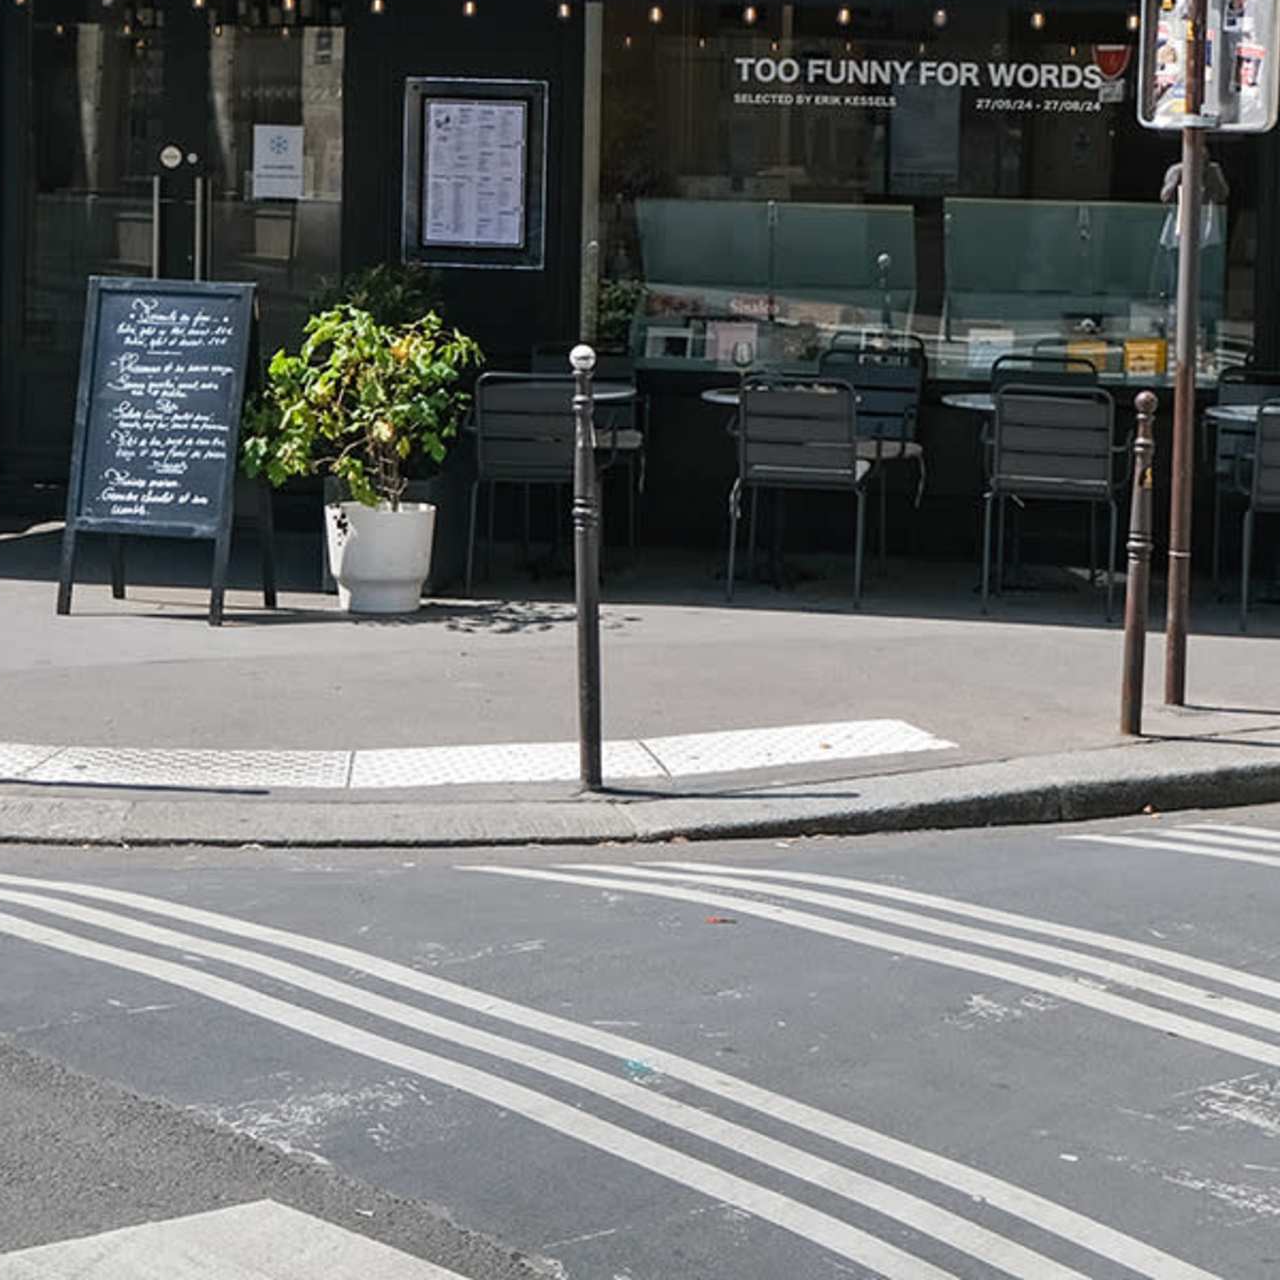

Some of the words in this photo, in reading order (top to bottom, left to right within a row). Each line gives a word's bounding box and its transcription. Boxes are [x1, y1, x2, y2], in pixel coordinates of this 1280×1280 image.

[734, 58, 800, 82] TOO
[808, 60, 913, 85] FUNNY
[920, 62, 980, 87] FOR
[987, 63, 1103, 89] WORDS
[734, 94, 793, 104] SELECTED
[796, 94, 812, 105] BY
